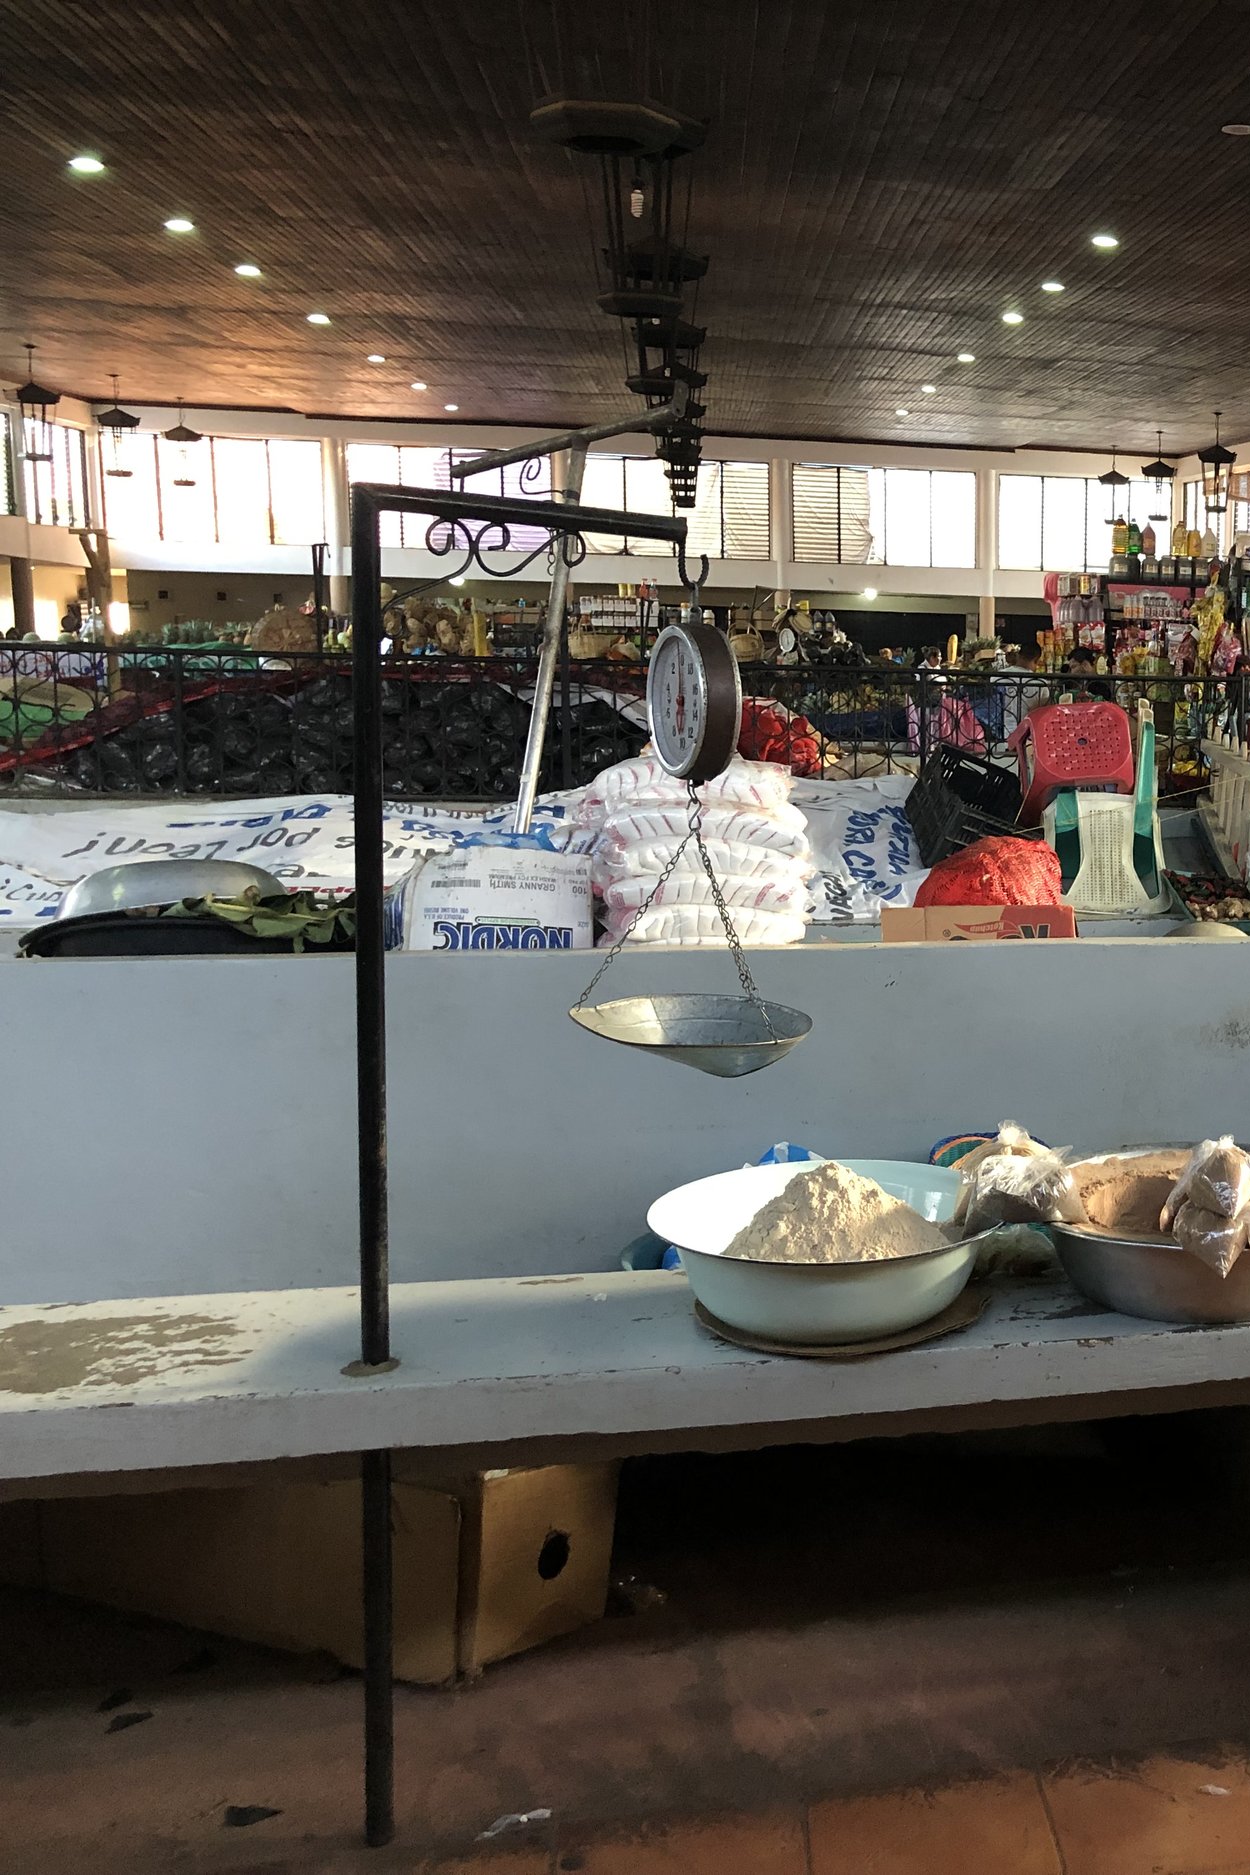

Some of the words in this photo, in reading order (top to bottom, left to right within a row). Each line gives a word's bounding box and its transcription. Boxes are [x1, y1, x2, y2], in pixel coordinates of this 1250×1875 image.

[237, 826, 321, 852] por
[489, 878, 517, 890] SMITH
[519, 881, 556, 892] GRANNY
[572, 886, 587, 894] 100
[969, 921, 1005, 933] Ketchup
[433, 921, 573, 950] NORDIC
